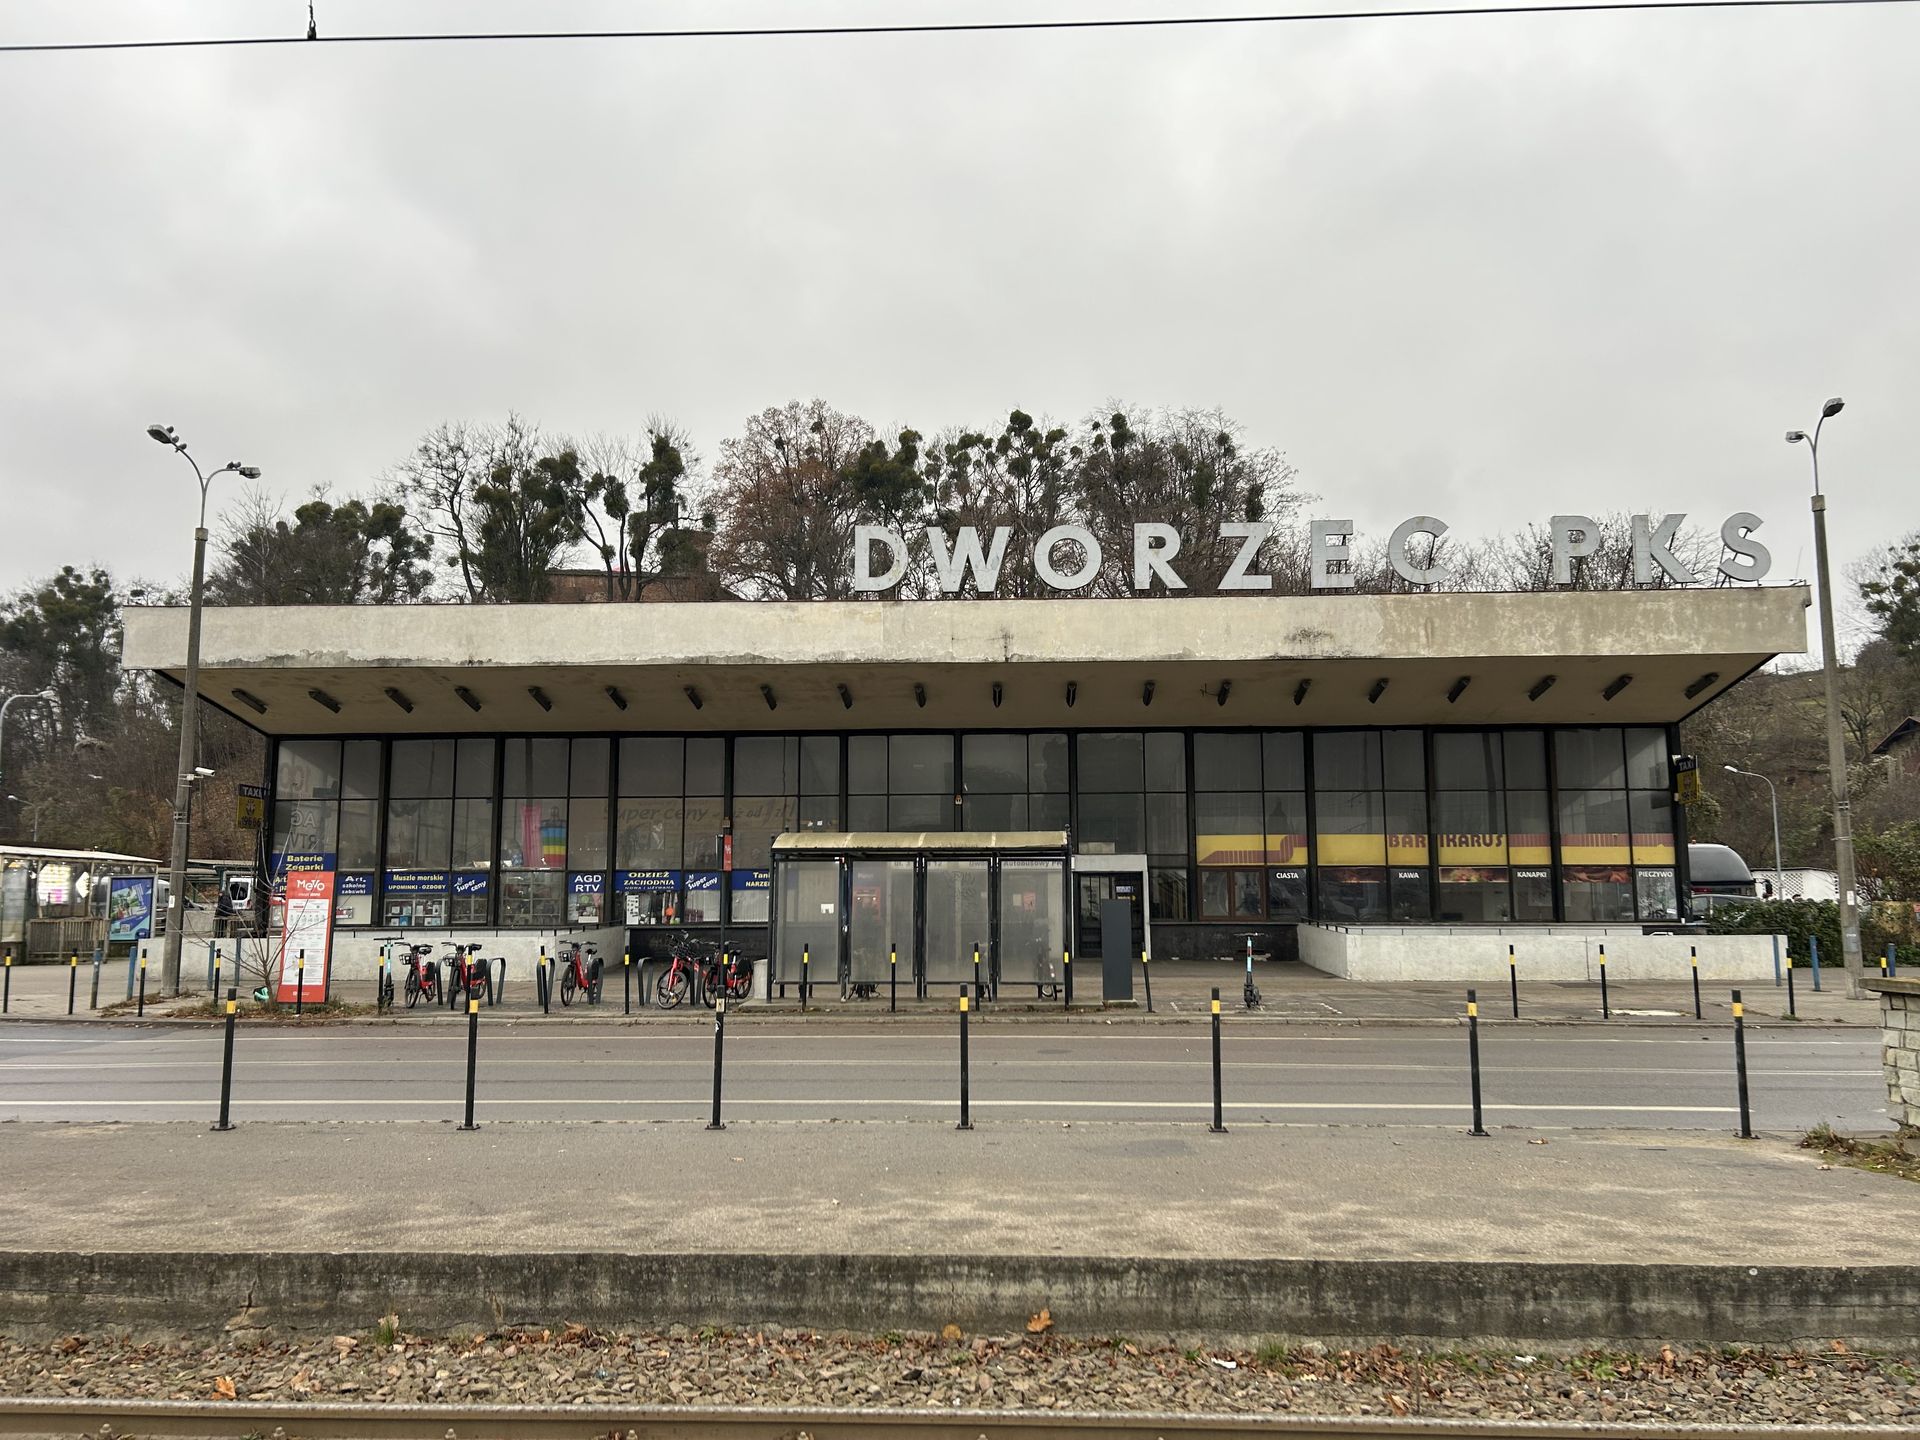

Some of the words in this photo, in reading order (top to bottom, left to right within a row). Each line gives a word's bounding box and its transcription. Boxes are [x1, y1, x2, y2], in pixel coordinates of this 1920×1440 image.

[854, 515, 1450, 592] DWORZEC
[1550, 511, 1772, 585] PKS
[1679, 761, 1694, 771] TAXI
[242, 786, 263, 798] TAXI
[1388, 834, 1427, 848] BAR
[1439, 834, 1503, 848] IKARUS
[574, 875, 602, 883] AGD
[703, 877, 718, 888] ceny
[471, 881, 487, 891] ceny
[575, 884, 600, 892] RTV
